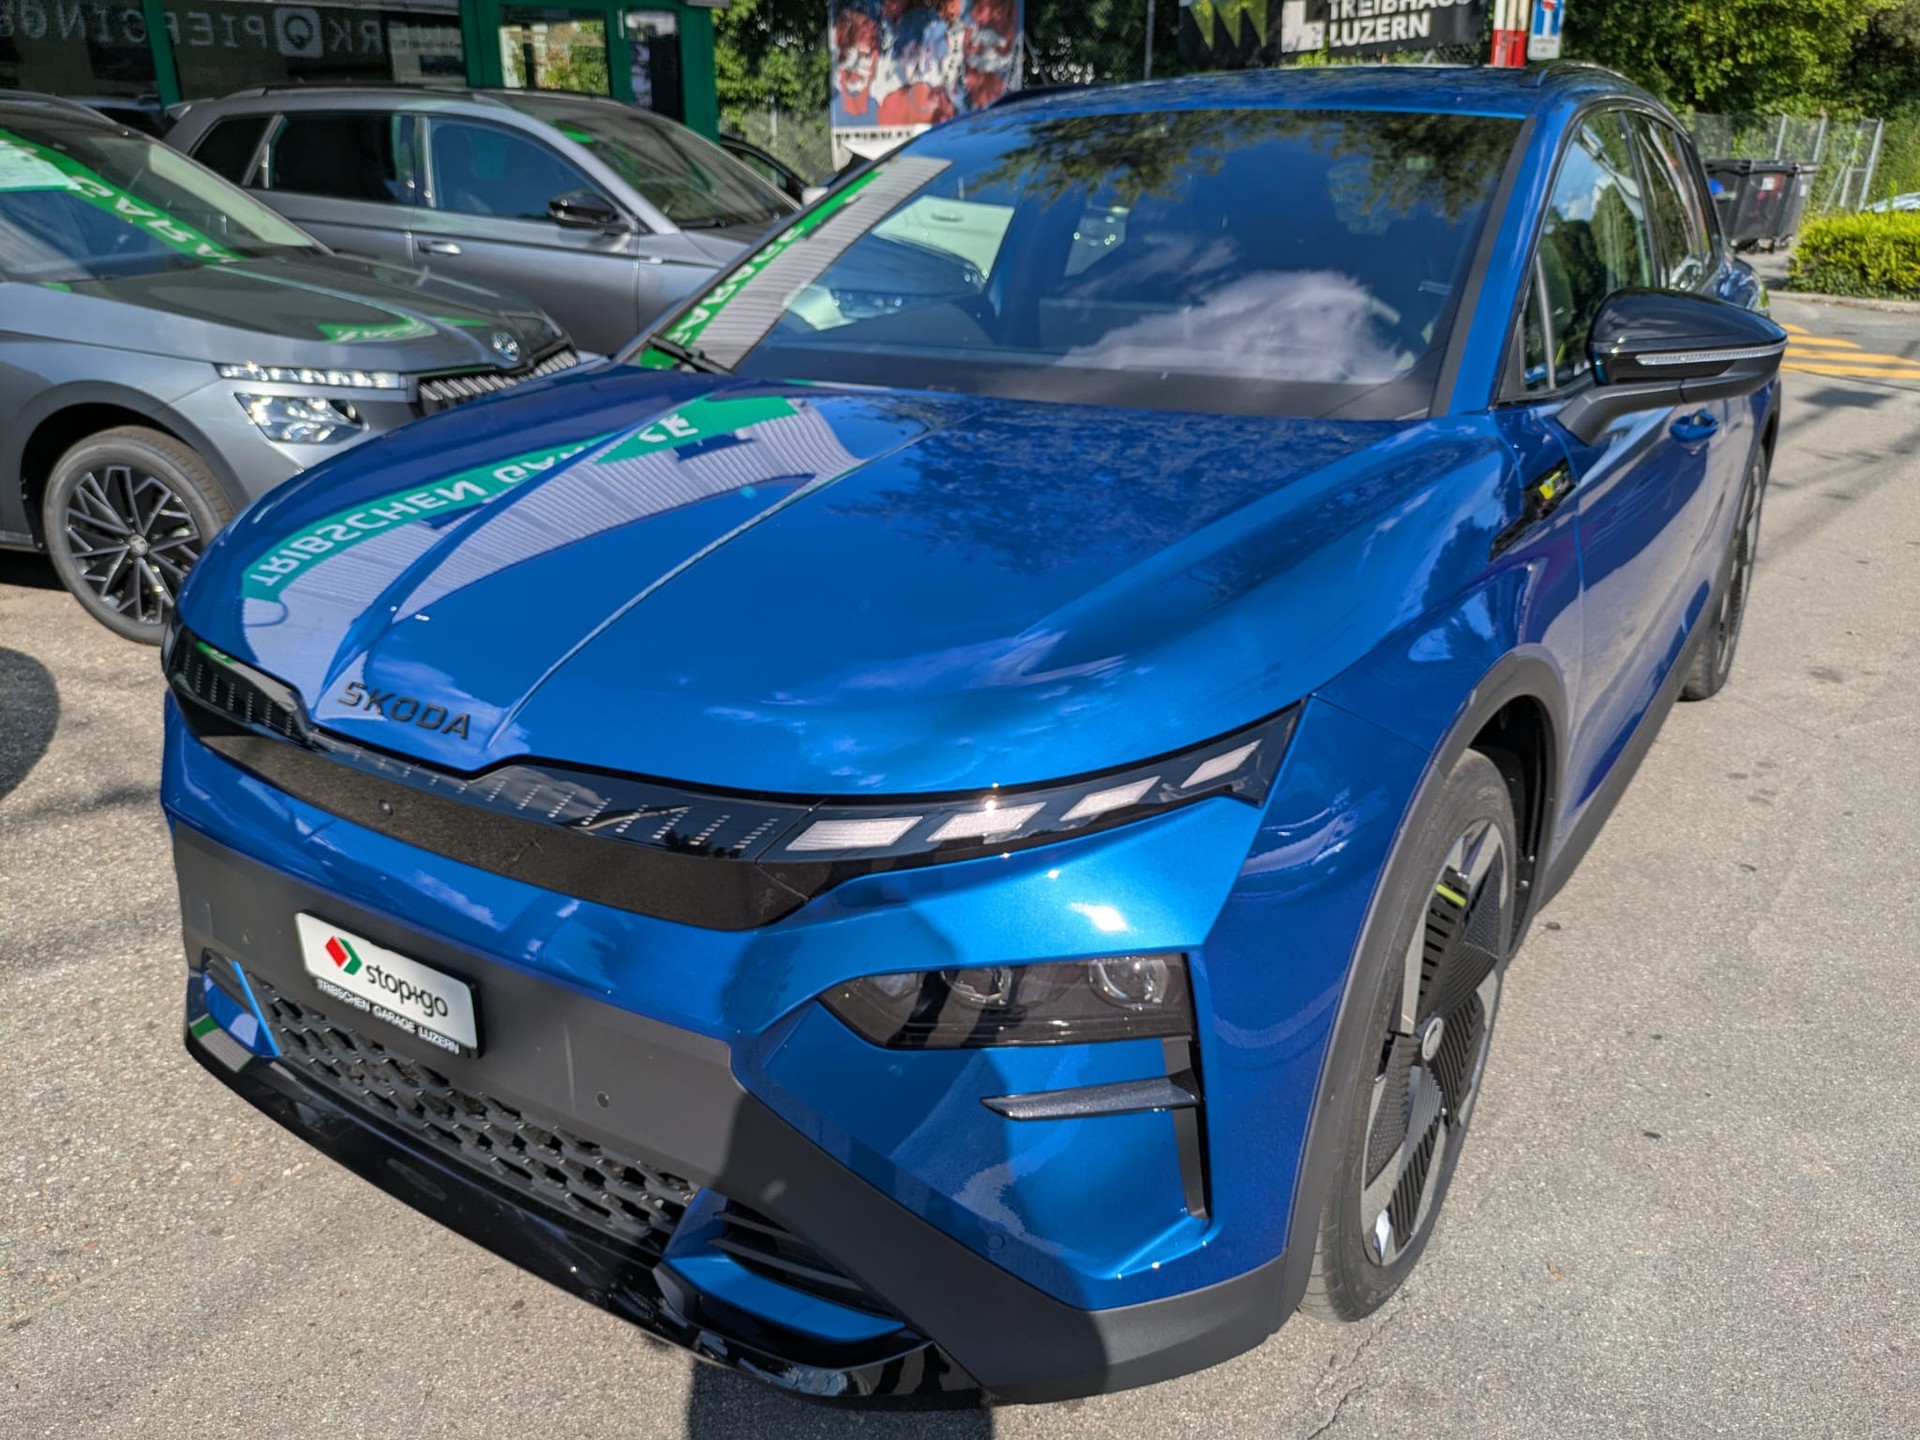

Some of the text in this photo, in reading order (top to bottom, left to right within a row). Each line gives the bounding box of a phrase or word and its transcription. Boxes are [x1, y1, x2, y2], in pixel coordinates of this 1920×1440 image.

[1329, 0, 1470, 20] TREIB
[1329, 12, 1431, 47] LUZERN
[366, 965, 448, 1017] stop+go
[316, 979, 460, 1055] TRIBSCHEN GARAGE LUZERN
